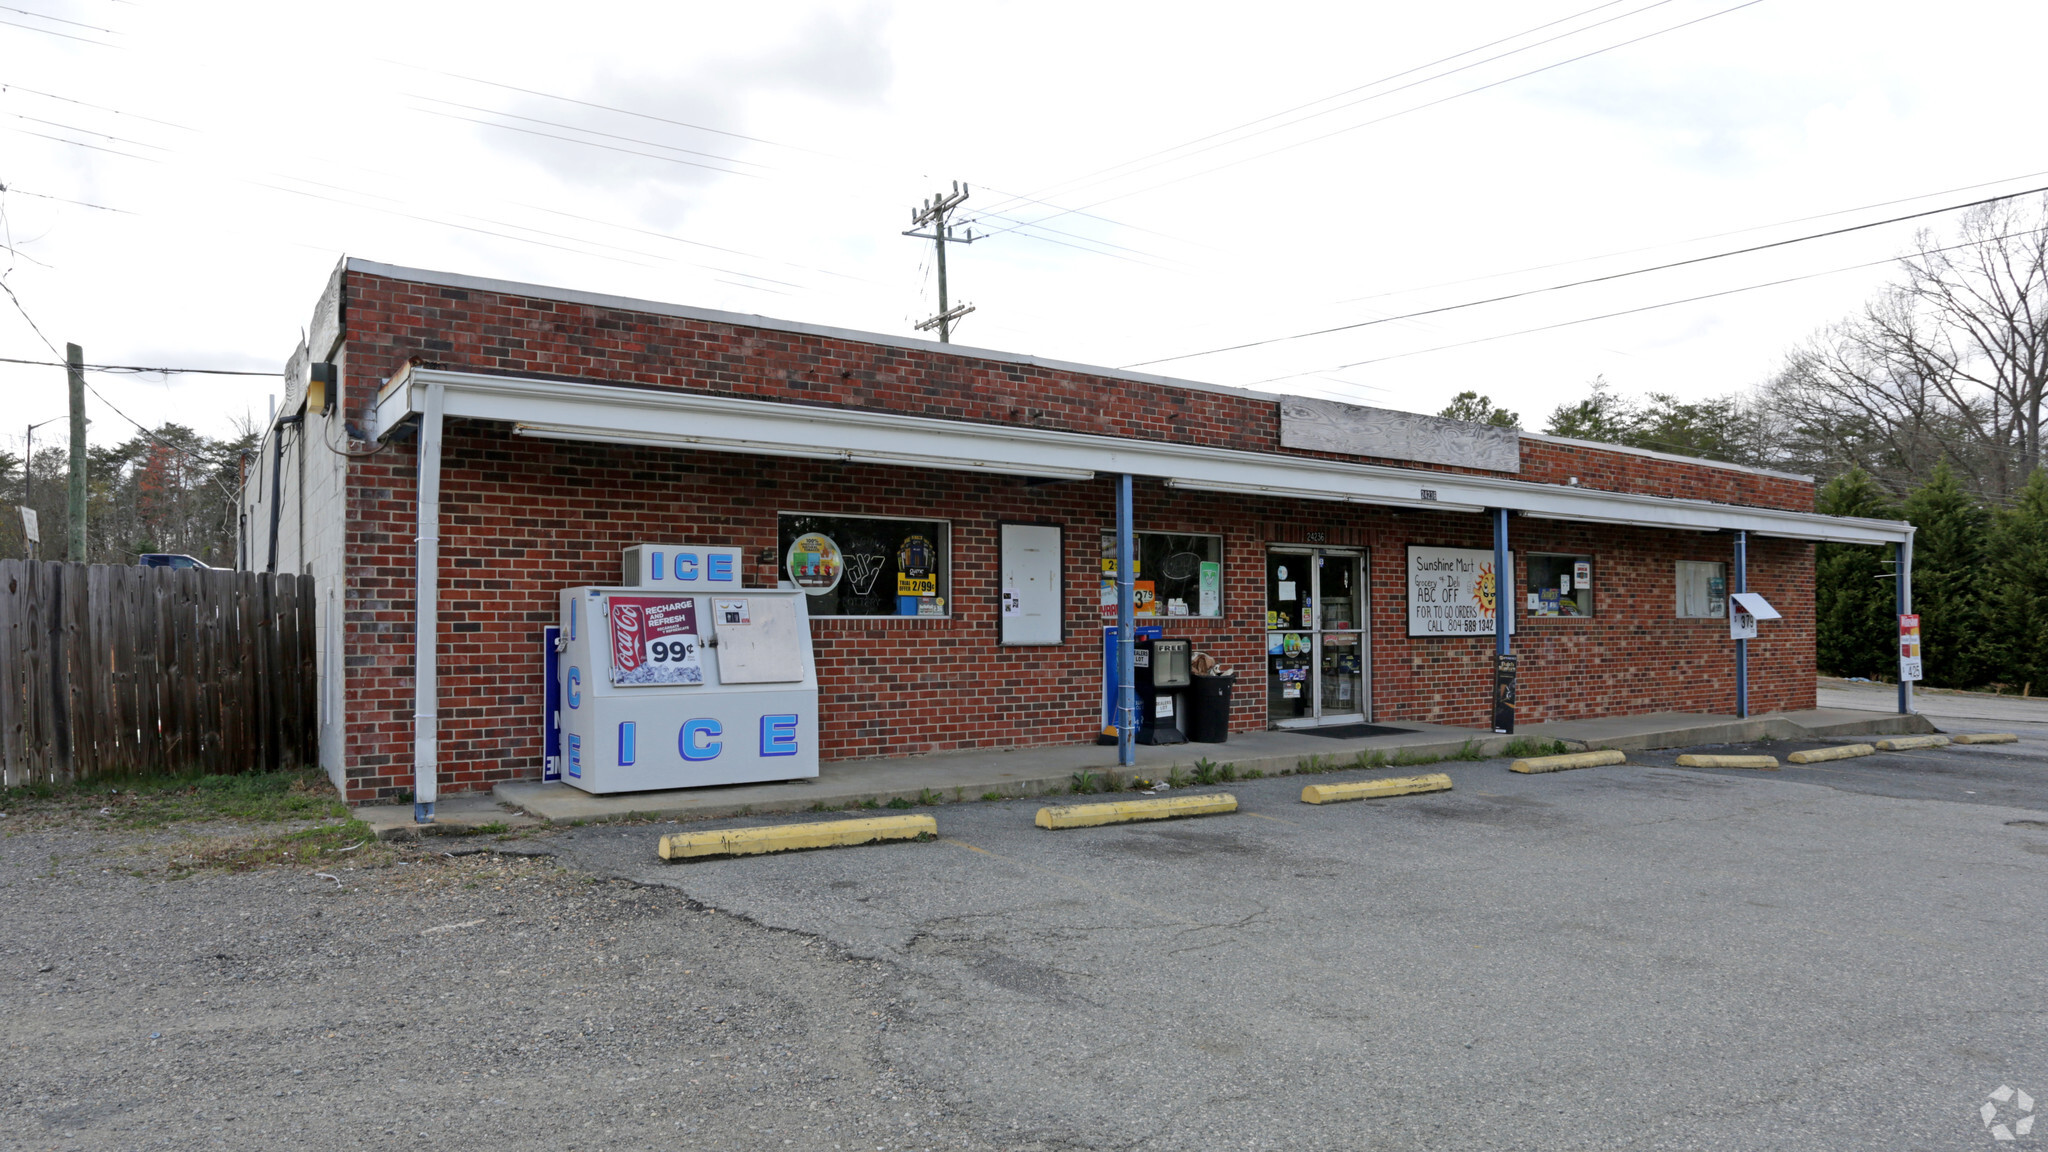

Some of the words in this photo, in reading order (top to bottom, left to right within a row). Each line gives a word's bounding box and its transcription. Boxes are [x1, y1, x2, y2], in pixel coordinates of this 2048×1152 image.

[1306, 532, 1324, 541] 24236
[652, 552, 733, 581] ICE
[1416, 556, 1454, 571] Sunshine
[1456, 558, 1475, 573] Mart
[1414, 574, 1438, 589] Grocery
[1447, 575, 1460, 587] Deli
[1417, 587, 1436, 603] ABC
[1442, 588, 1459, 603] OFF
[645, 600, 693, 615] RECHARGE
[1416, 605, 1431, 618] FOR
[1433, 605, 1443, 618] TO
[1444, 605, 1454, 619] GO
[1454, 606, 1478, 619] ORDERS
[648, 614, 686, 628] REFRESH
[1427, 620, 1444, 632] CALL
[617, 714, 799, 766] ICE
